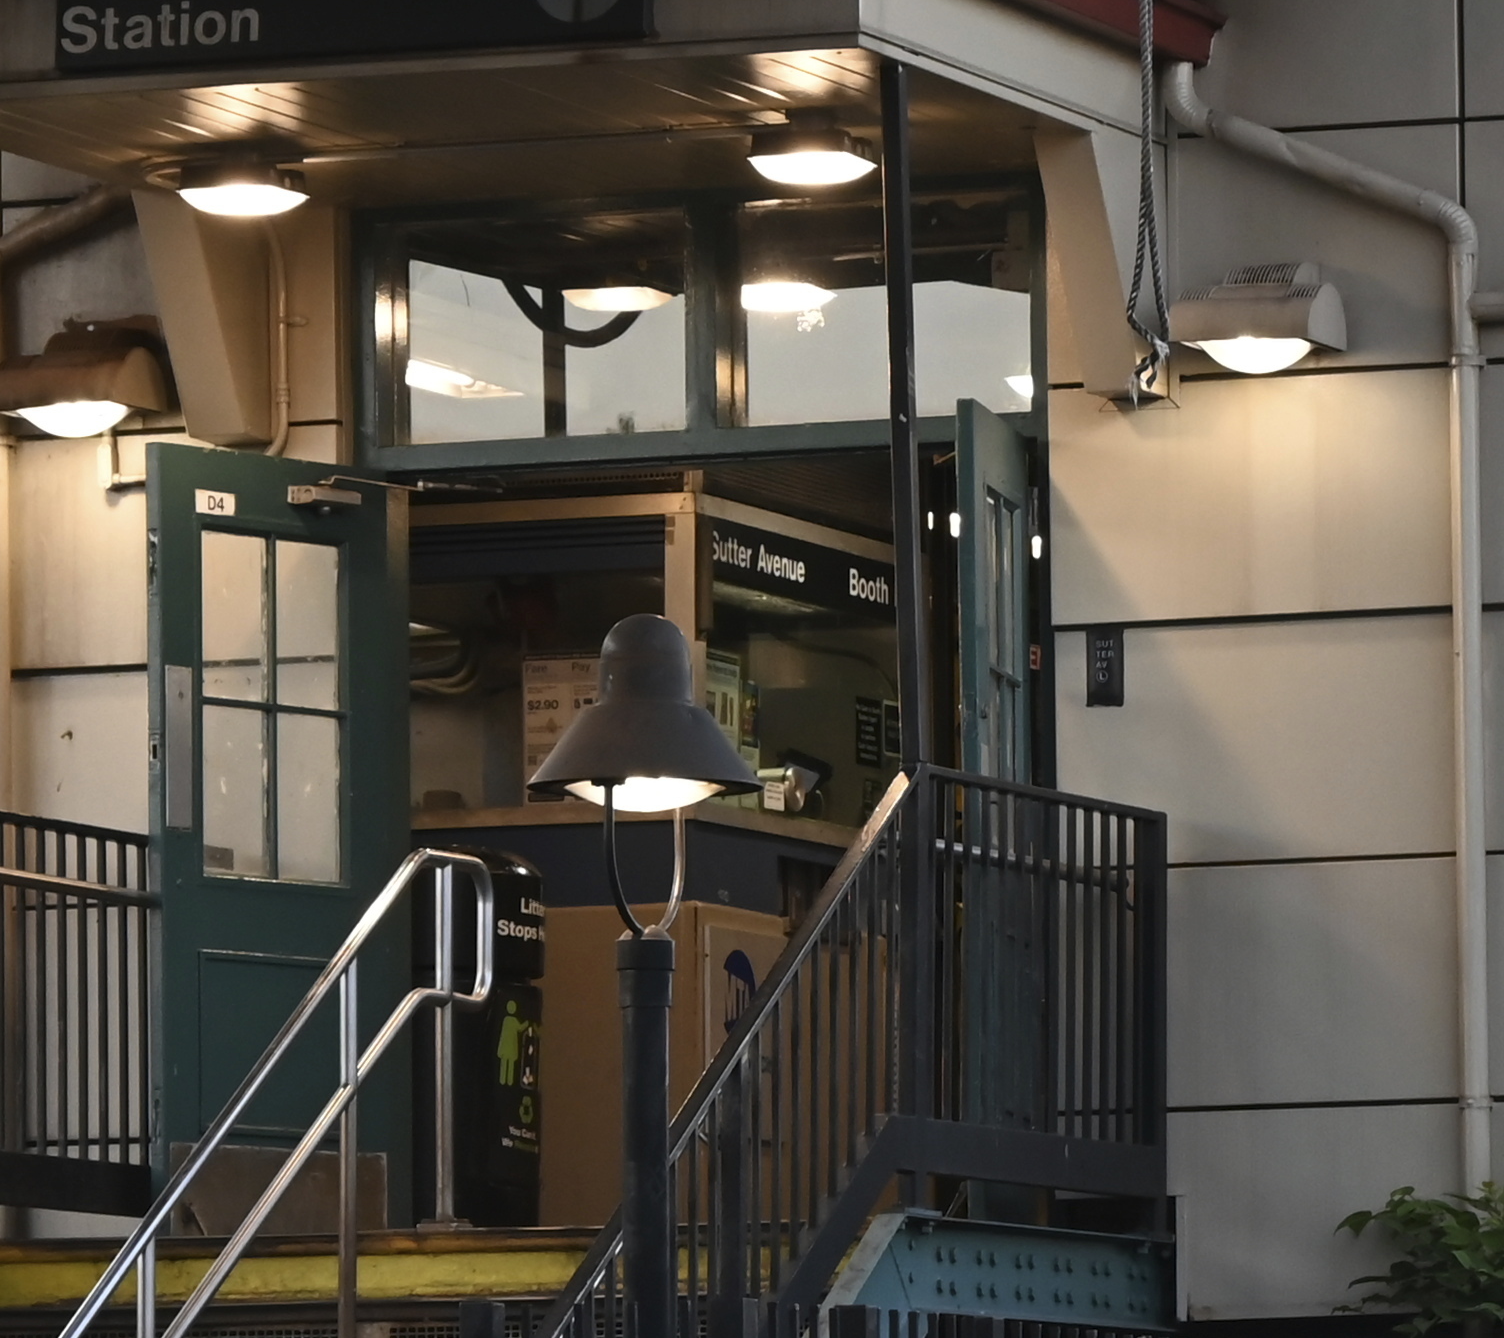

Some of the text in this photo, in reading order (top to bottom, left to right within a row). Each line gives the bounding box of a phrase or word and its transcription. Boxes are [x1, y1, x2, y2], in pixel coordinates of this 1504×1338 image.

[62, 1, 259, 53] Station
[208, 495, 224, 512] D4
[713, 531, 889, 605] Sutter Avenue Booth
[528, 700, 559, 710] $2.90
[497, 919, 537, 941] Stops
